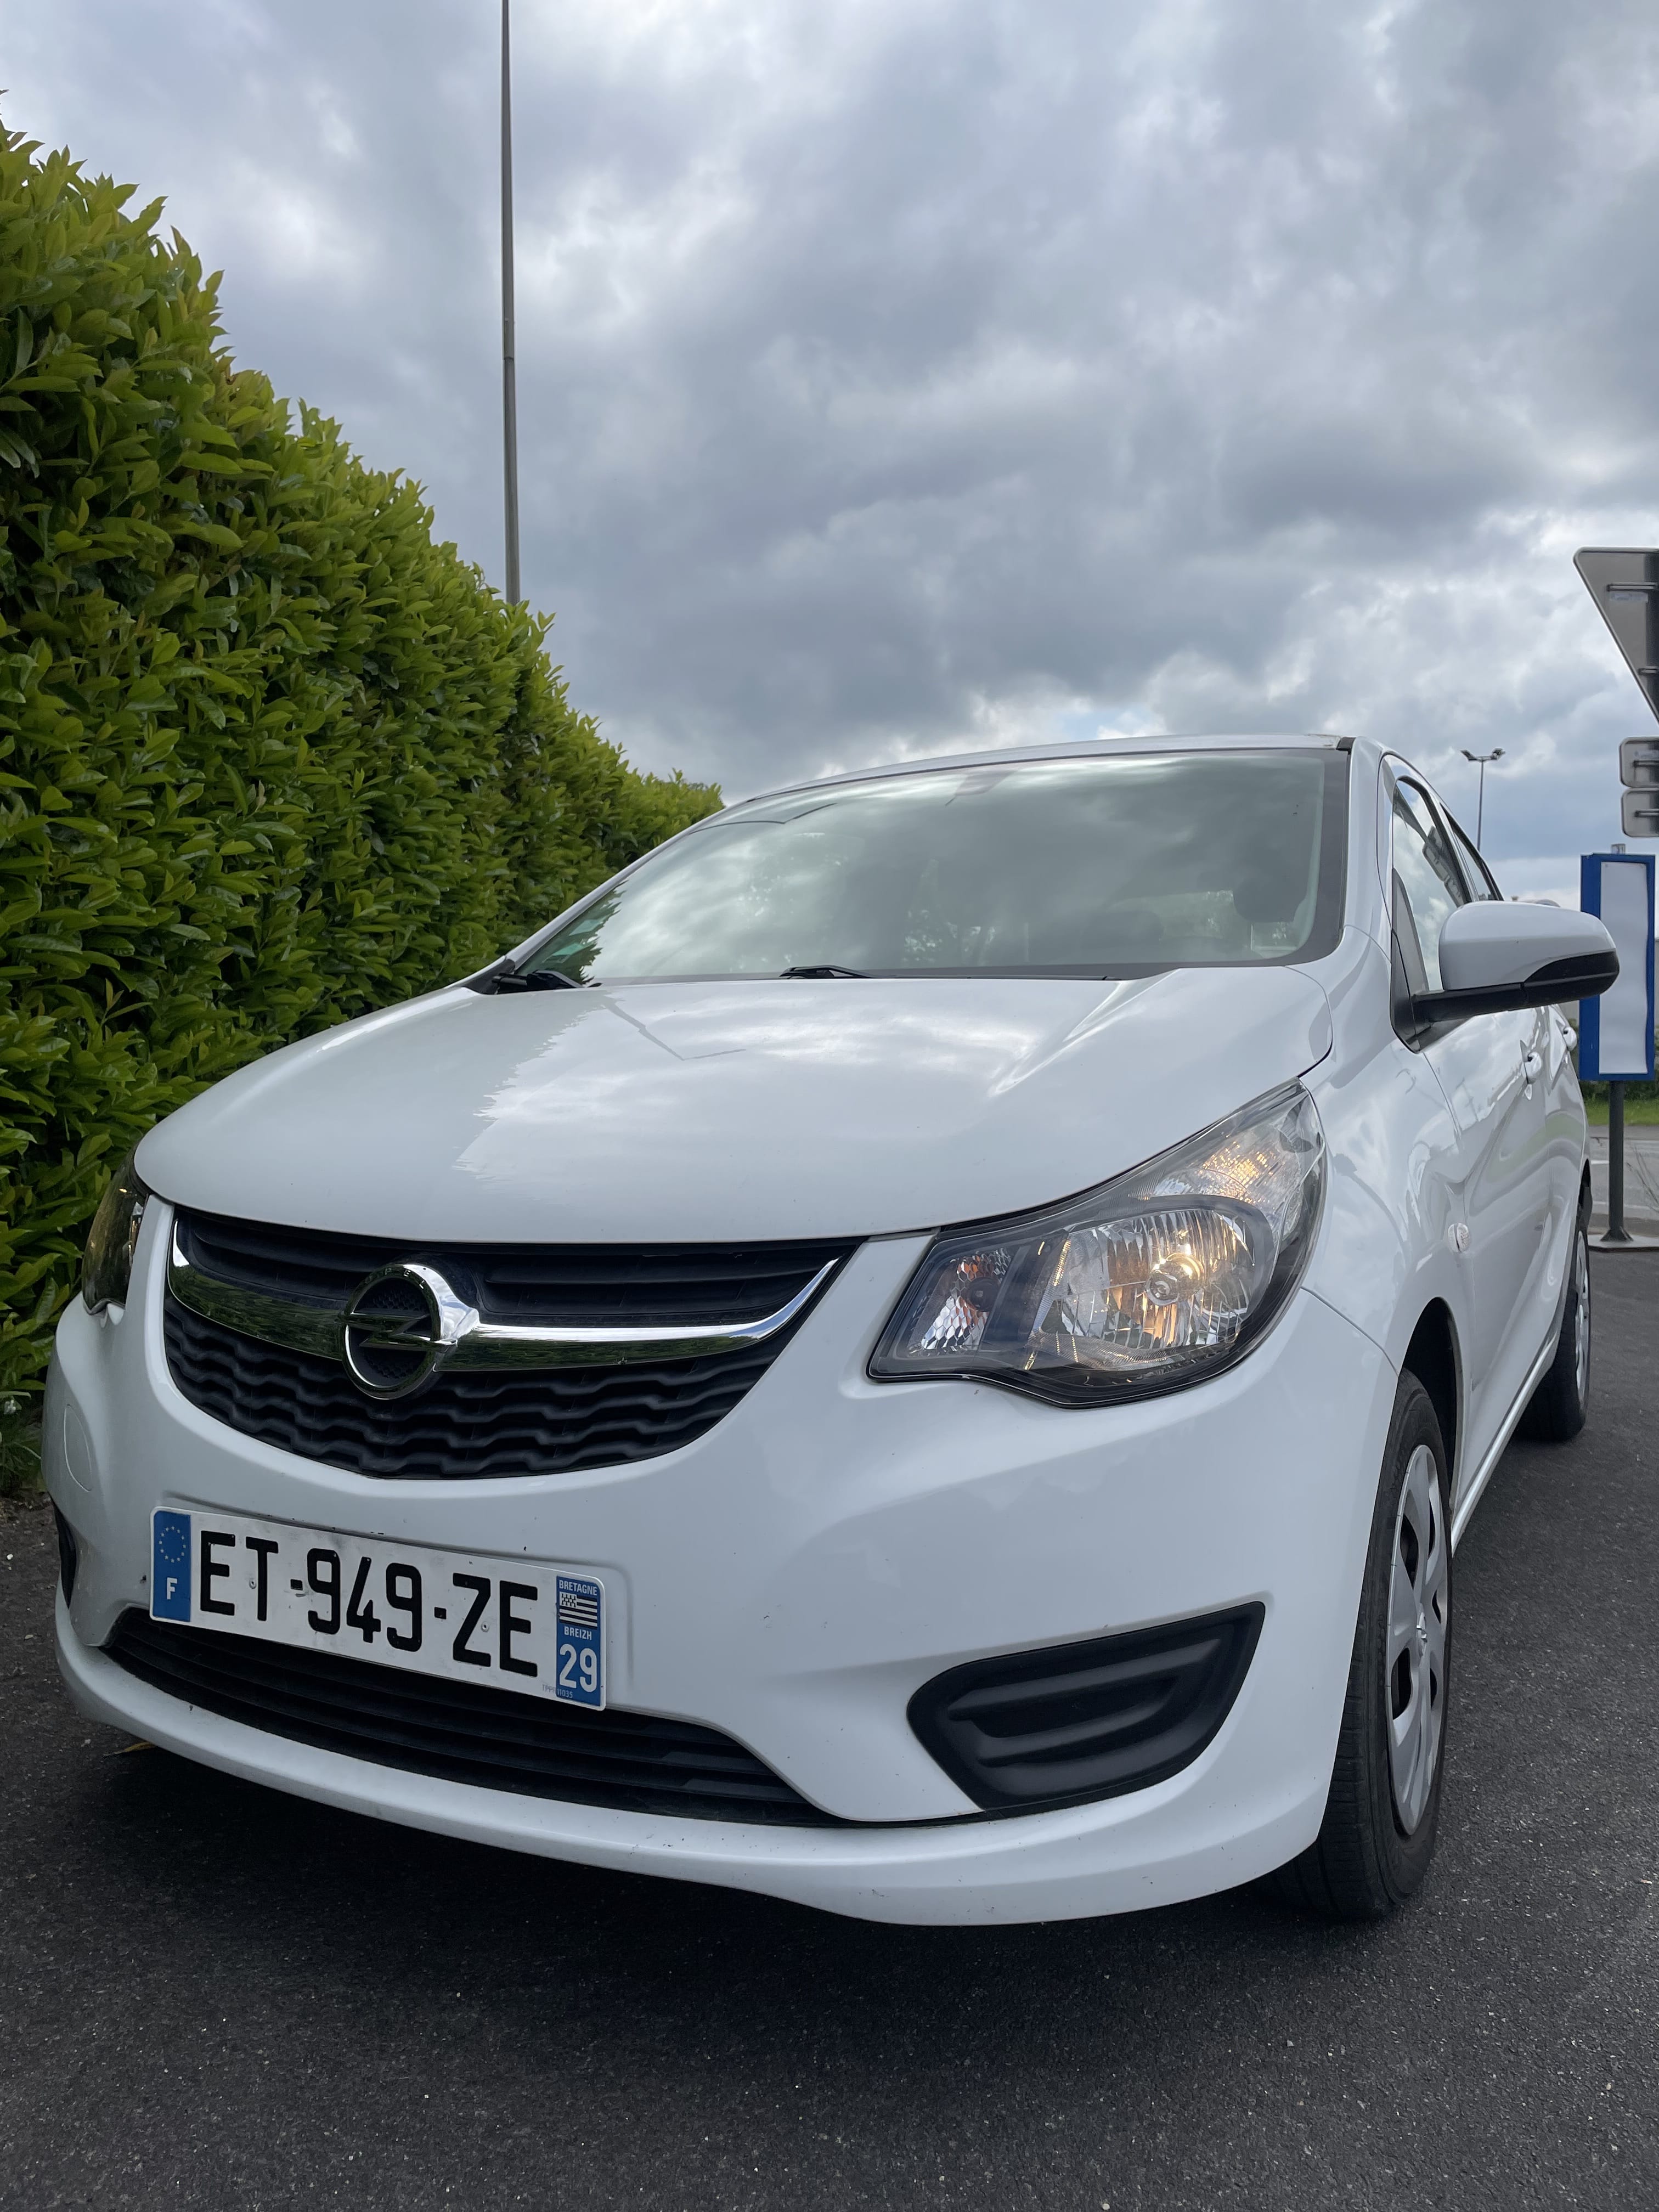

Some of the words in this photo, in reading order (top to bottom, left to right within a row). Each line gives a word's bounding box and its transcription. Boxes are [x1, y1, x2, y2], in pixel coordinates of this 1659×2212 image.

[365, 1267, 426, 1289] OPEL
[166, 1577, 178, 1600] F
[559, 1579, 597, 1596] BRETAGNE
[200, 1530, 538, 1678] ET-949-ZE
[564, 1626, 592, 1640] BREIZH
[559, 1643, 597, 1692] 29
